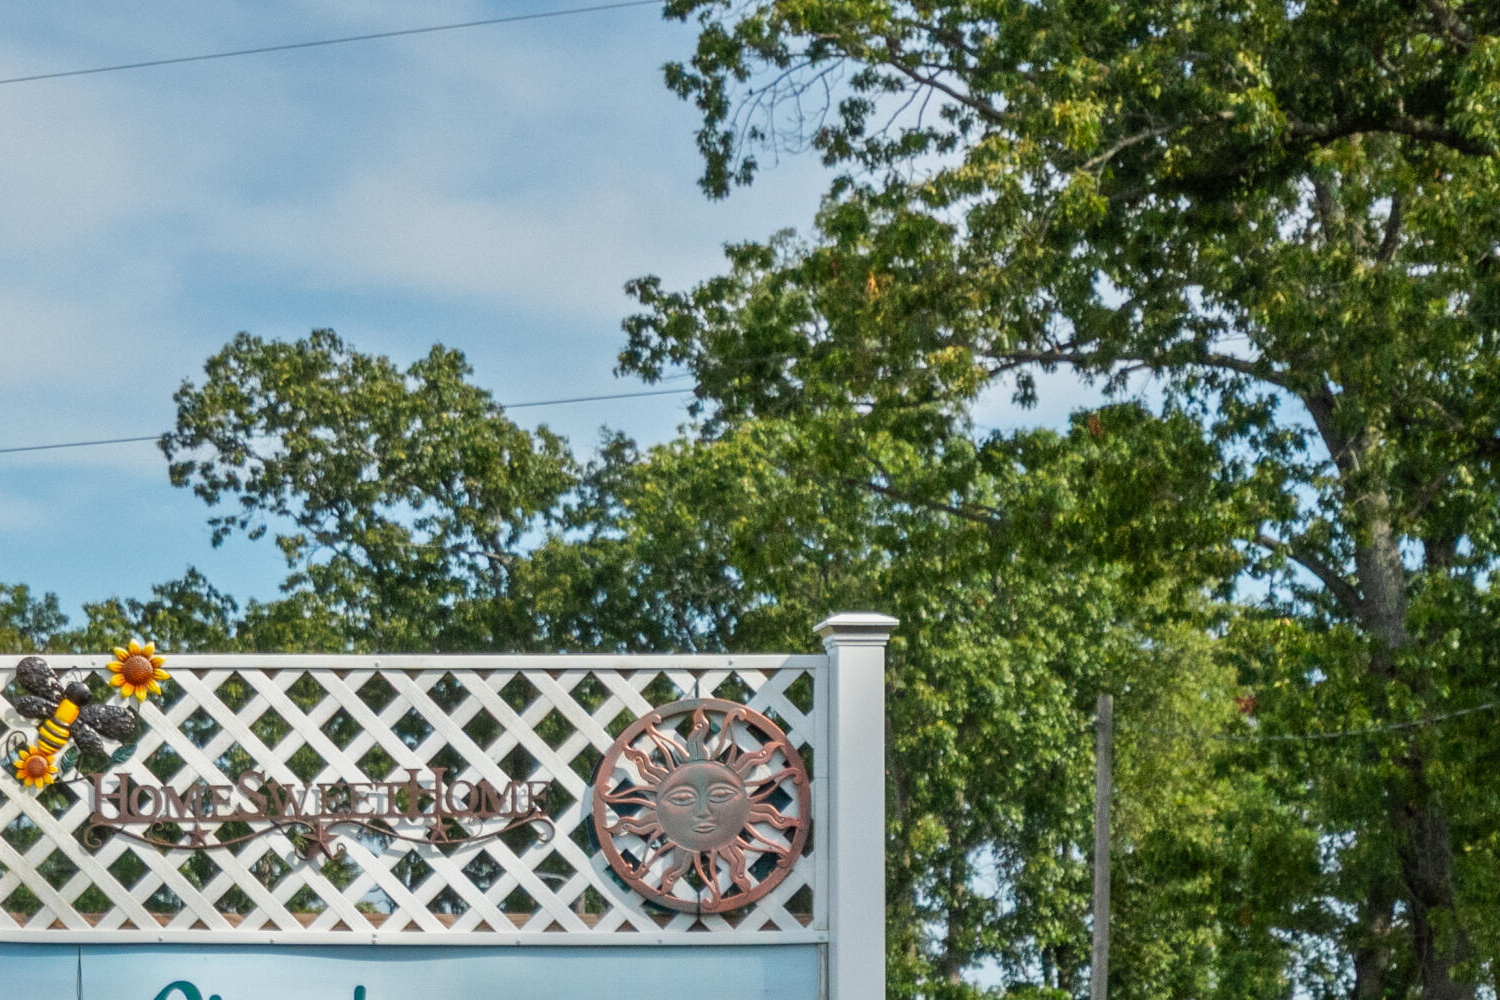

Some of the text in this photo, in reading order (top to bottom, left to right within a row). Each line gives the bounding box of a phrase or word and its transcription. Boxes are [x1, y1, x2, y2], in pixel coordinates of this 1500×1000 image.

[92, 767, 551, 819] HOME SWEET HOME
